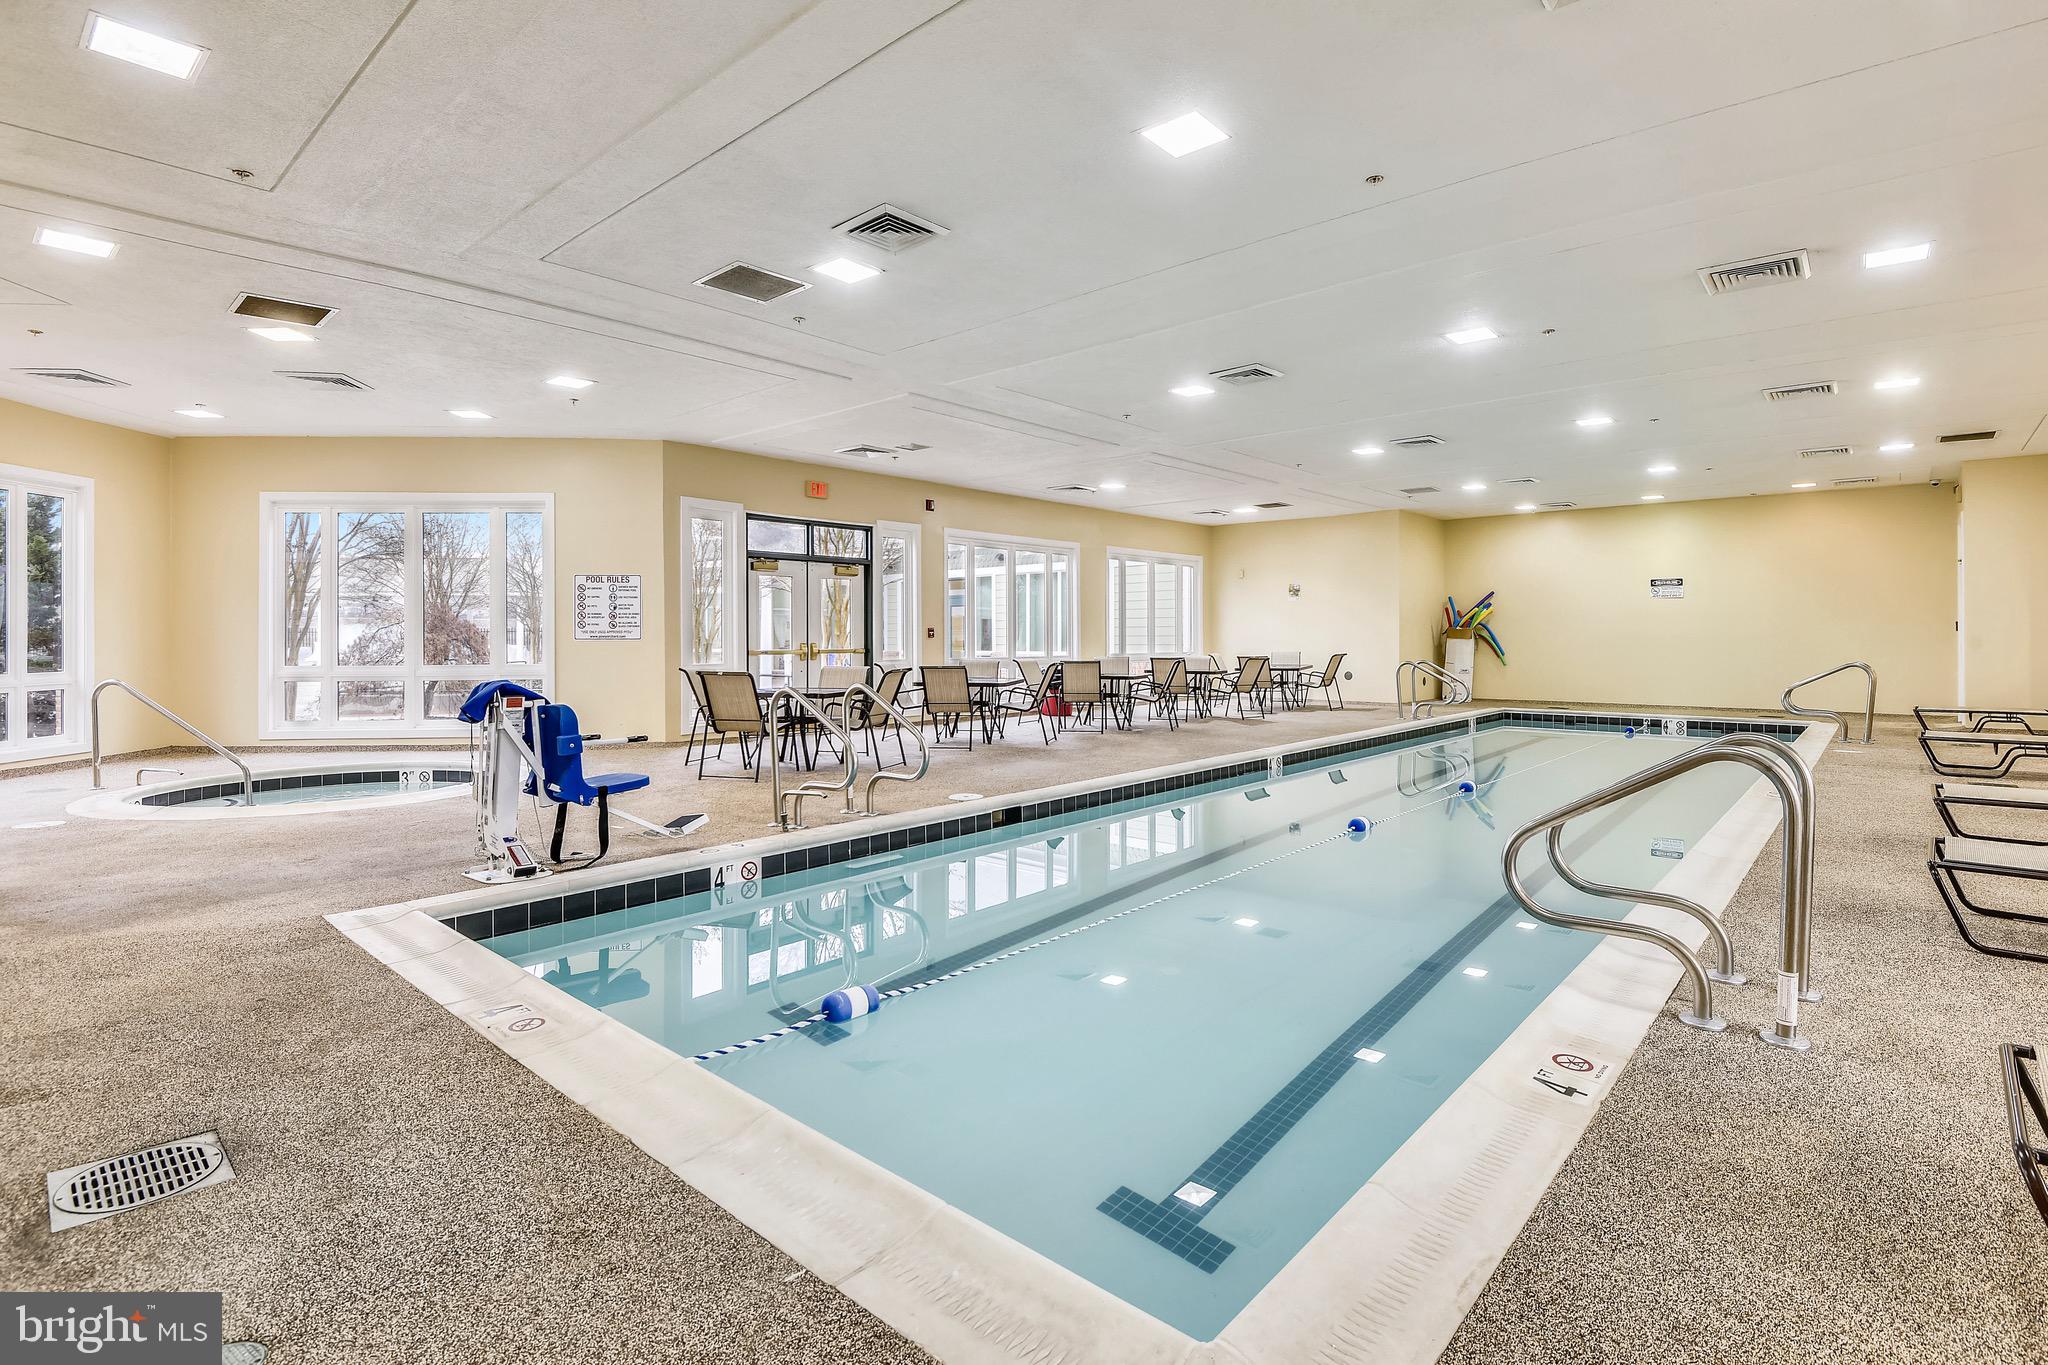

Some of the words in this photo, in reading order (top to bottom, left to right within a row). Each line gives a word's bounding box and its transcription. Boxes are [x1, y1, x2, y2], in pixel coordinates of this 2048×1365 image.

[714, 866, 725, 888] 4
[725, 864, 734, 873] FT
[1536, 1068, 1554, 1080] FT
[1532, 1076, 1588, 1098] 4
